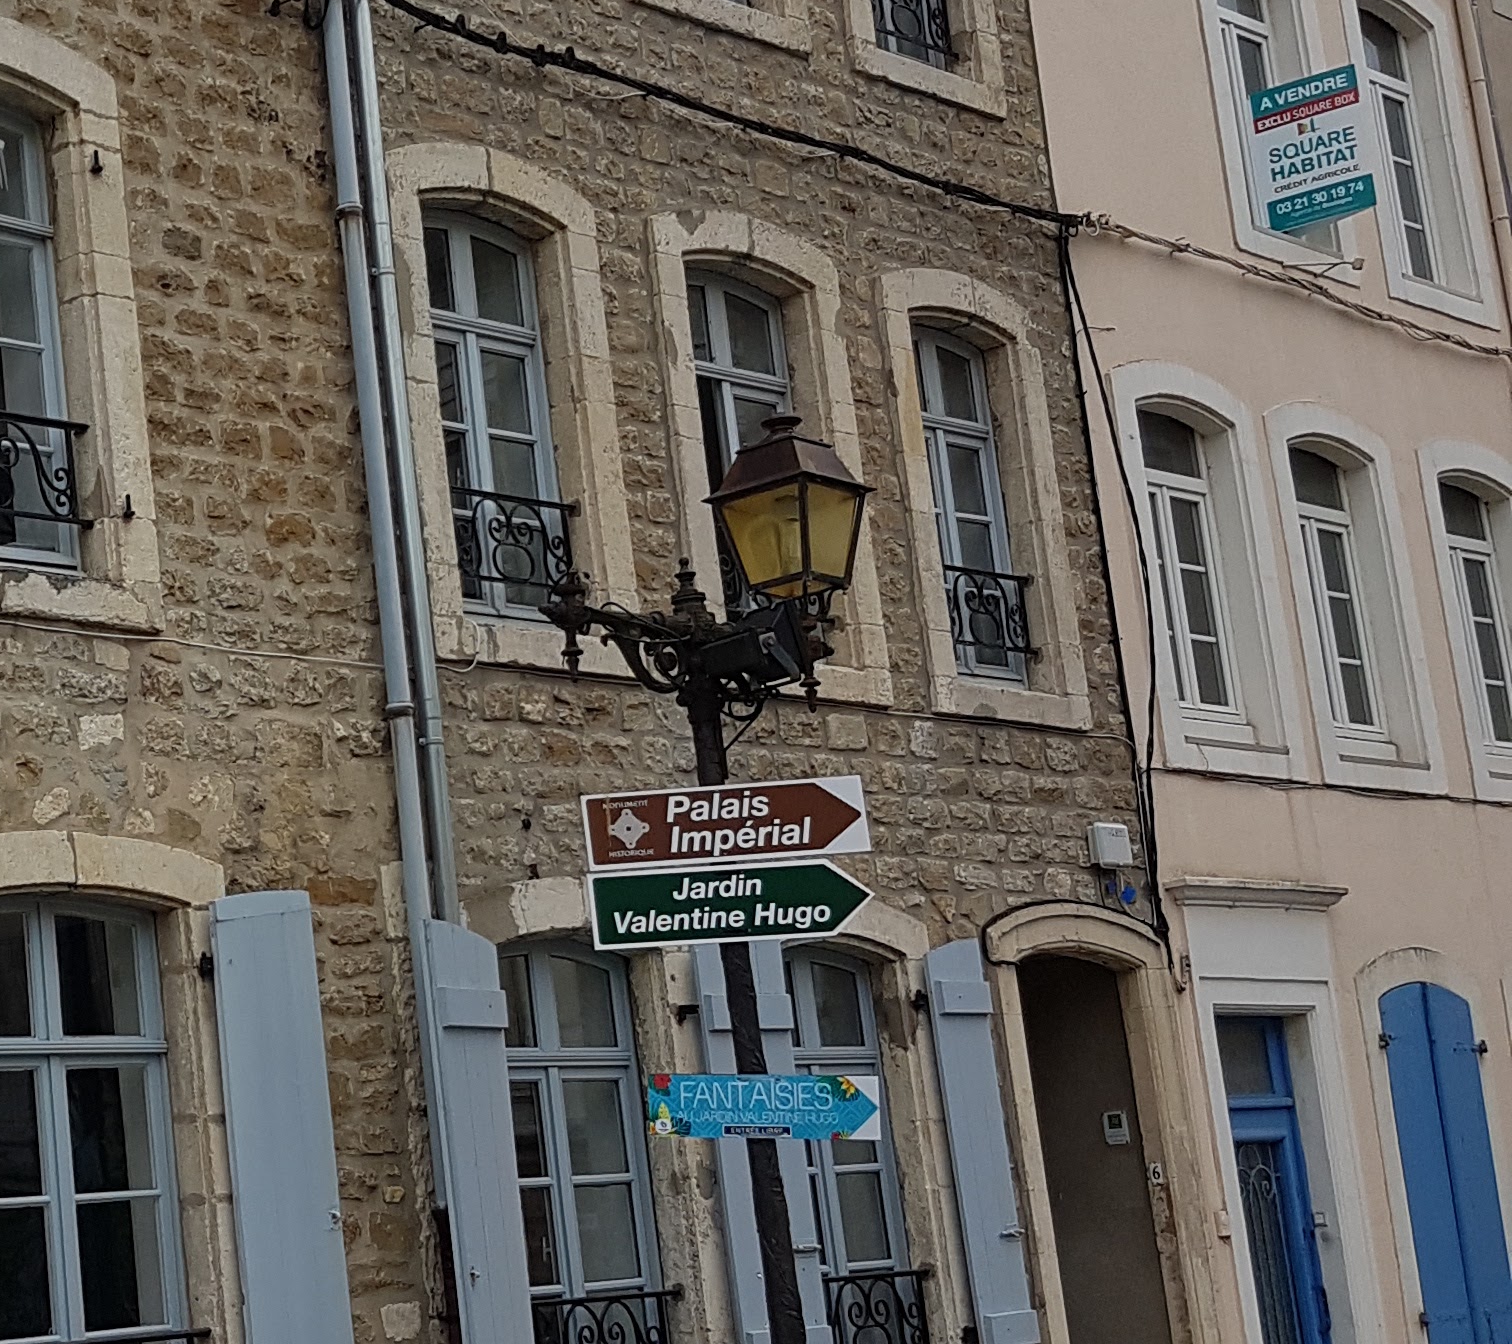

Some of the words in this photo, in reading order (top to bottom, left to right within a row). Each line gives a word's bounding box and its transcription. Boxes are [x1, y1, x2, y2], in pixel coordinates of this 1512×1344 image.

[1260, 97, 1273, 111] A
[1275, 73, 1348, 105] VENDRE
[1257, 112, 1290, 131] EXCLU
[1293, 99, 1333, 120] SQUARE
[1334, 92, 1356, 107] BOX
[1269, 126, 1357, 164] SQUARE
[1271, 144, 1358, 182] HABITAT
[1311, 164, 1361, 183] AGRICOLE
[1276, 202, 1292, 215] 03
[1294, 197, 1309, 209] 21
[1312, 191, 1327, 204] 30
[1330, 186, 1346, 199] 19
[1348, 181, 1364, 194] 74
[666, 790, 770, 824] Palais
[670, 817, 811, 855] Impérial
[672, 874, 763, 902] Jardin
[613, 906, 746, 935] Valentine
[754, 902, 832, 930] Hugo
[679, 1081, 834, 1110] FANTAISIES
[1152, 1165, 1161, 1180] 6
